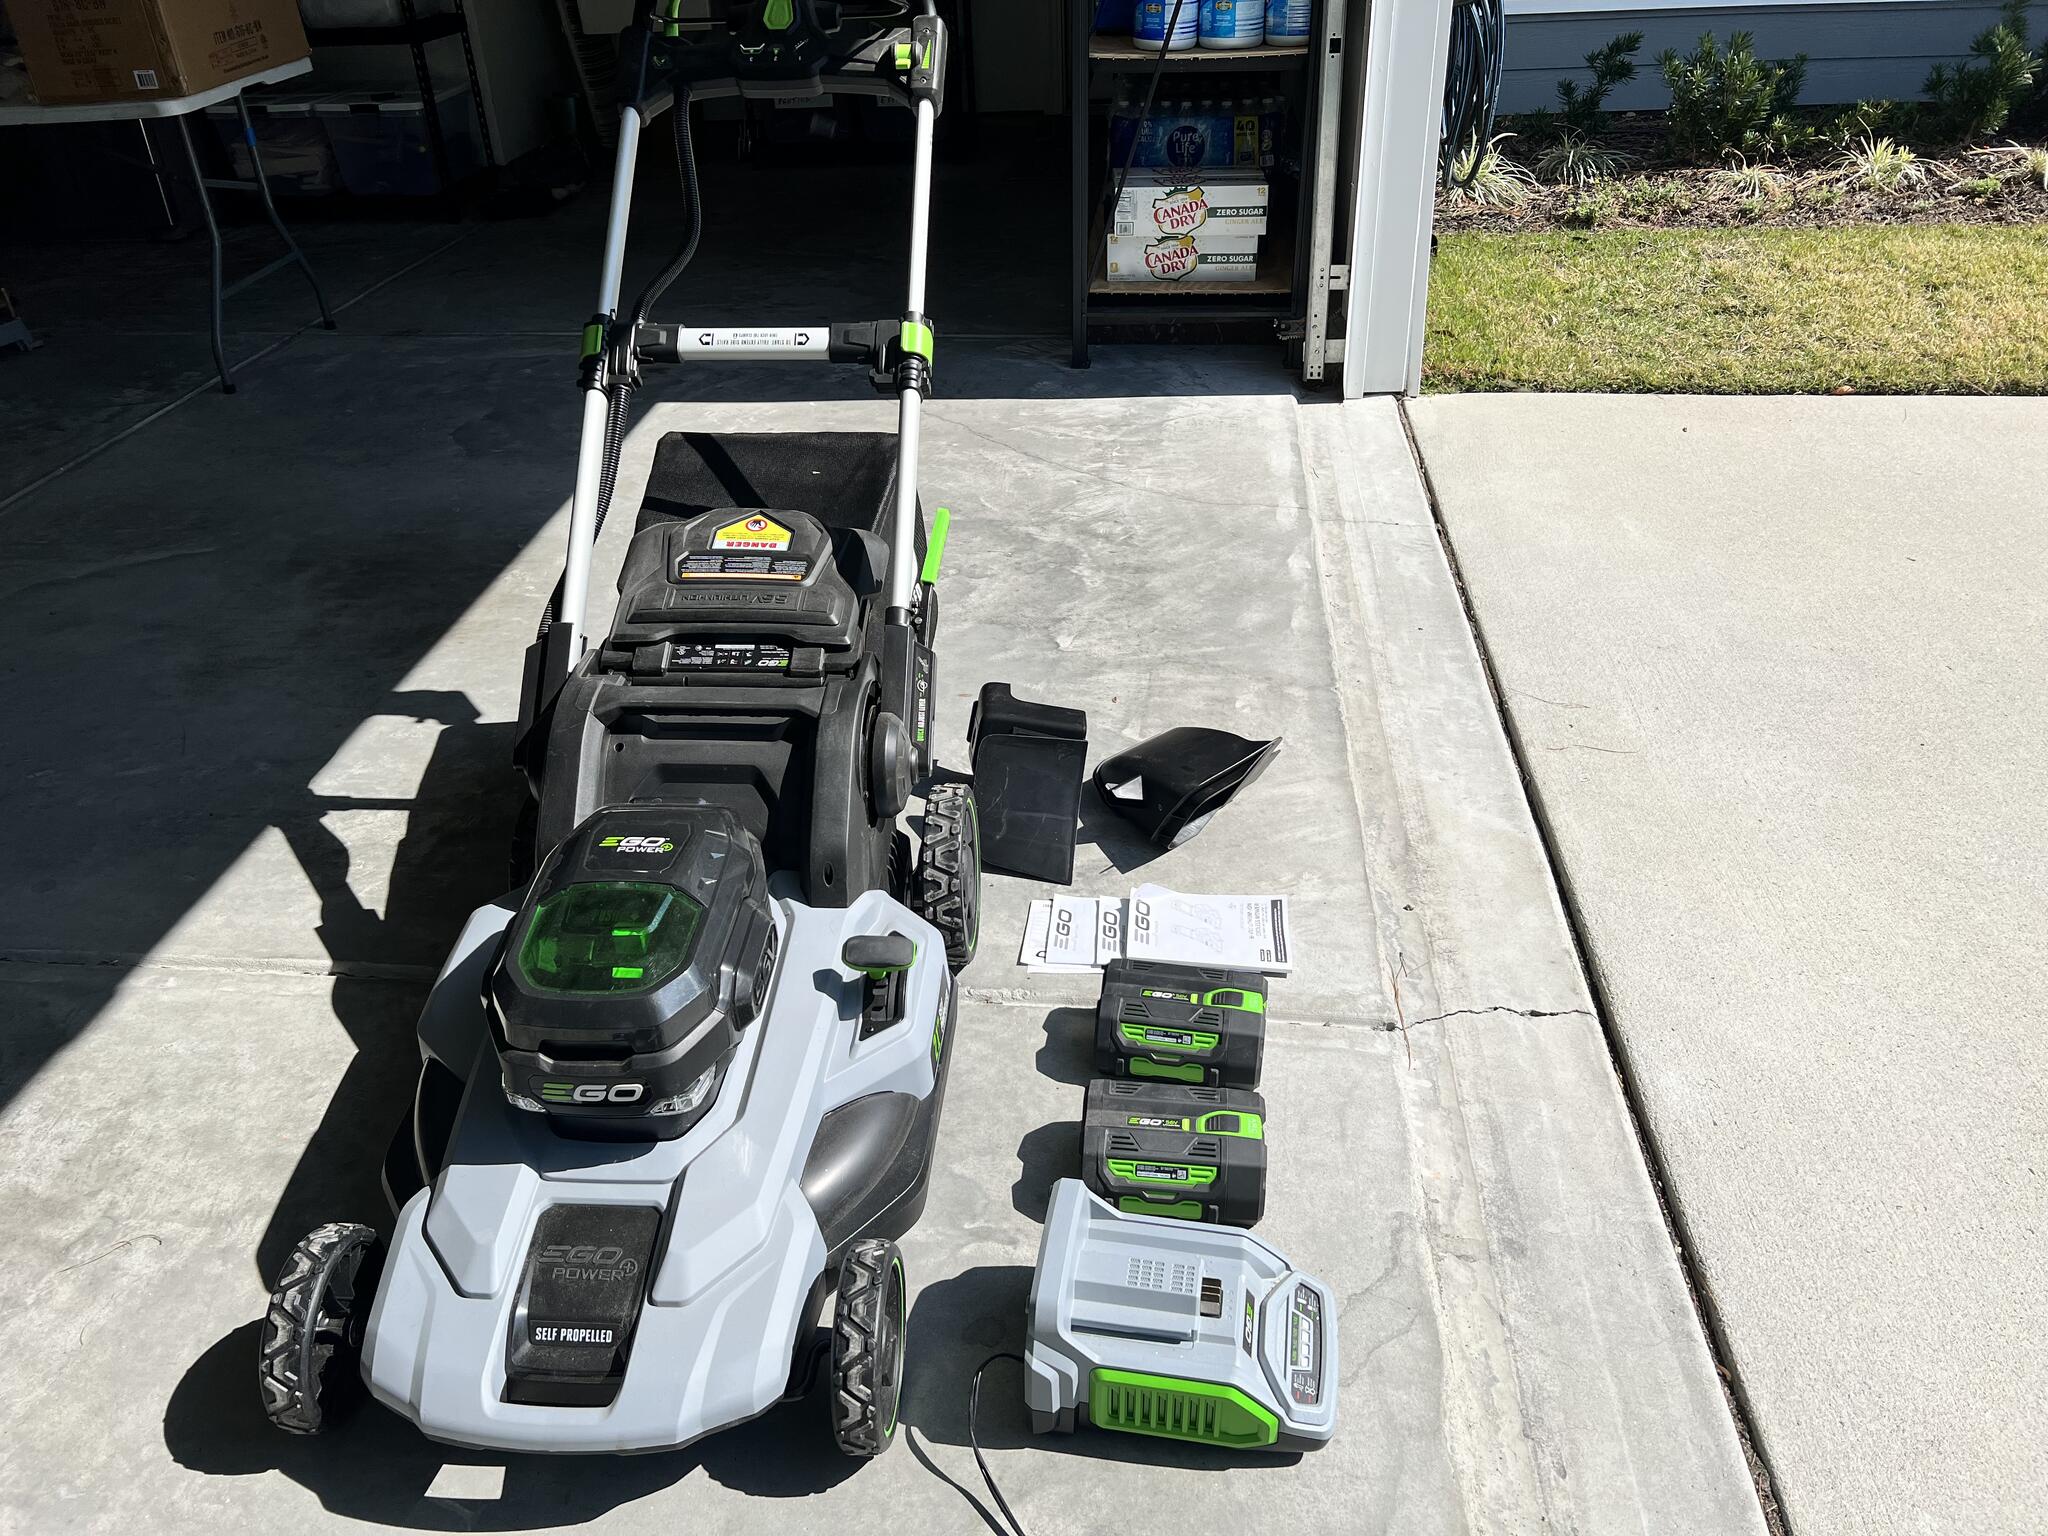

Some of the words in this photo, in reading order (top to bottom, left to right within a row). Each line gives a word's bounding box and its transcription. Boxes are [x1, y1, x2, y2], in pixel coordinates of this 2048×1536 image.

[1236, 120, 1255, 131] 40
[1173, 130, 1199, 143] Pure
[1176, 143, 1196, 153] Life
[1257, 187, 1266, 195] 12
[1153, 199, 1208, 225] CANADA
[1238, 208, 1264, 216] SUGAR
[1170, 213, 1198, 229] DRY
[1144, 245, 1199, 269] CANADA
[1161, 259, 1188, 274] DRY
[726, 541, 777, 549] DANGER
[757, 659, 789, 667] EGO
[918, 698, 926, 711] LEVER
[917, 712, 925, 728] ADJUST
[916, 728, 925, 742] QUICK
[599, 837, 665, 848] EGO
[1134, 899, 1151, 945] EGO
[1053, 909, 1072, 950] EGO
[1101, 911, 1118, 952] EGO
[1142, 990, 1173, 999] EGO
[542, 1083, 644, 1103] EGO
[1128, 1117, 1162, 1126] EGO
[539, 1245, 623, 1265] EGO
[1245, 1304, 1254, 1344] EGO
[535, 1327, 558, 1342] SELF
[560, 1327, 613, 1344] PROPELLED
